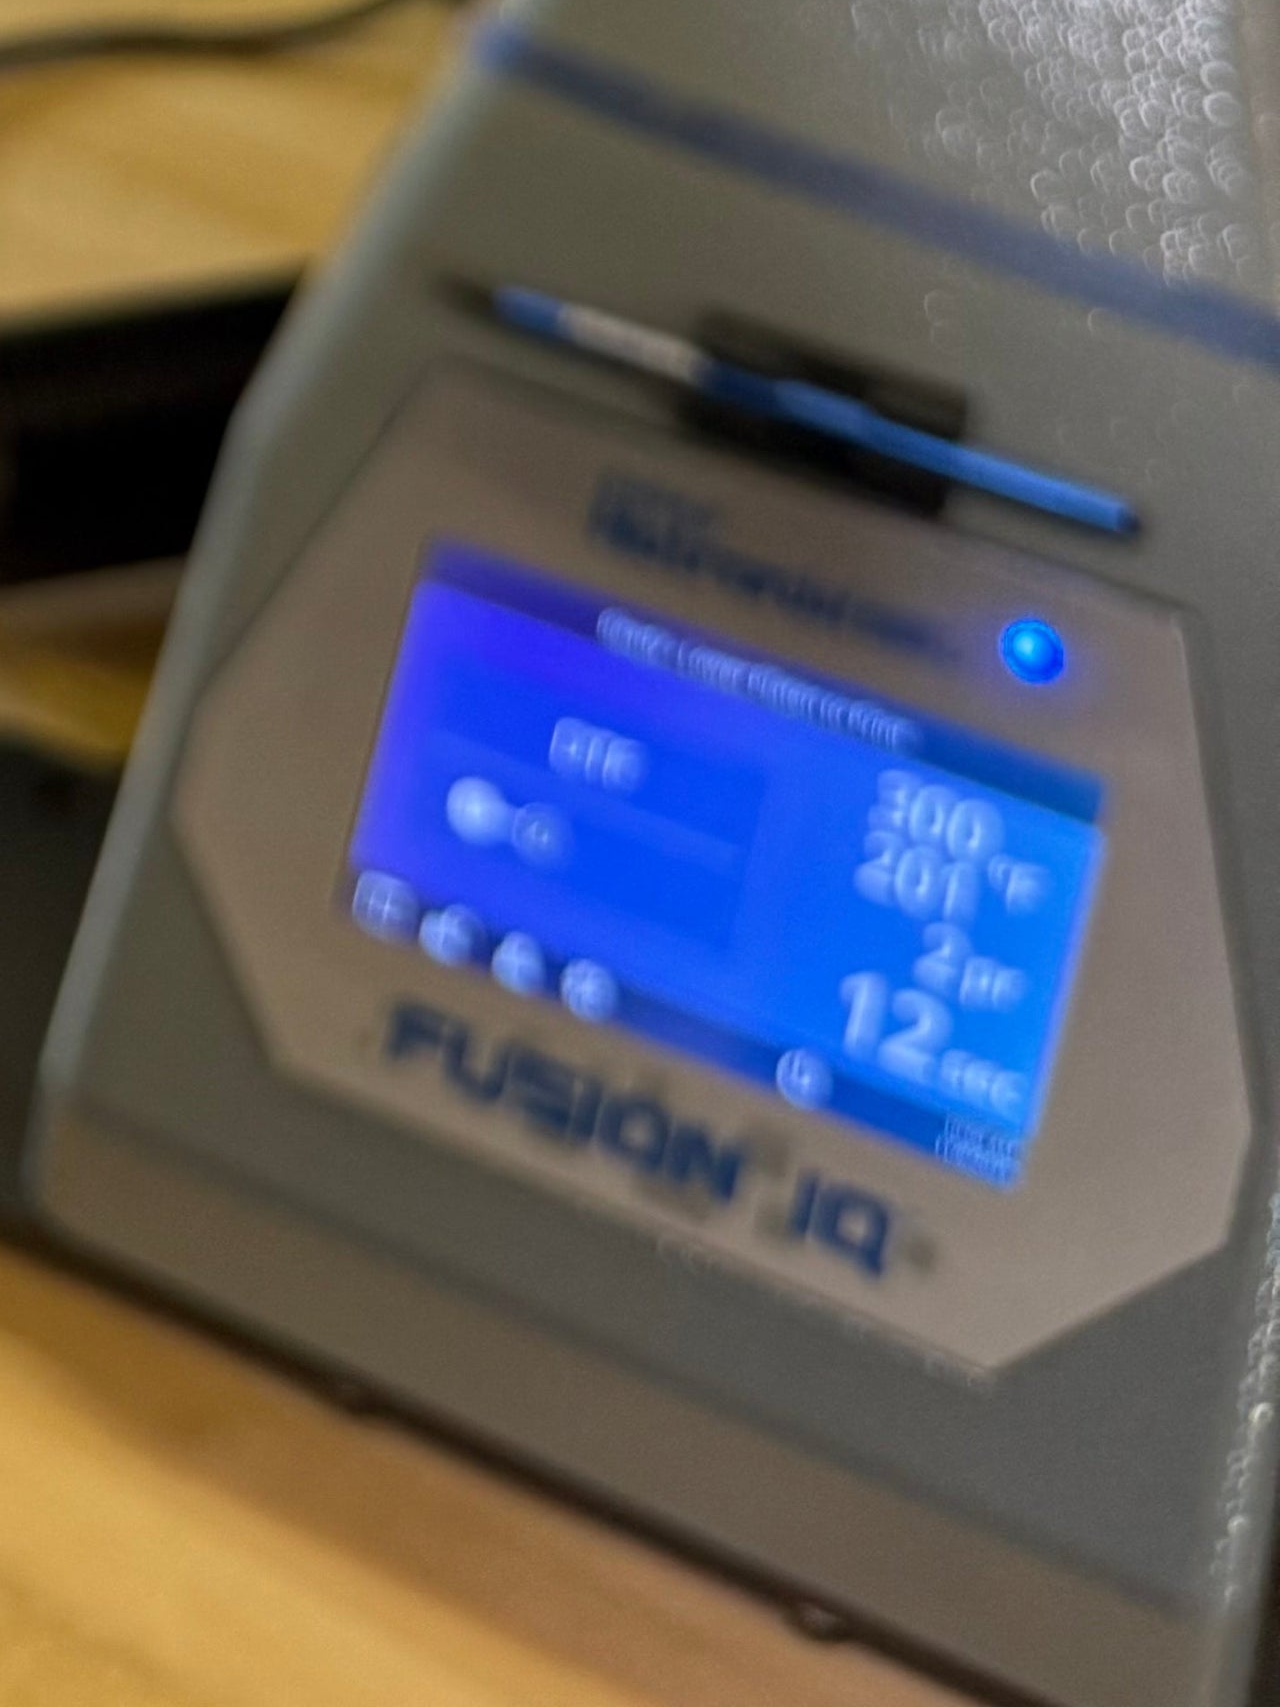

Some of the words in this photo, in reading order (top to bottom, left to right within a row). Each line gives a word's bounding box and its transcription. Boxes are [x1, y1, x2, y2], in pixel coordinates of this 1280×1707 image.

[841, 971, 953, 1083] 12
[385, 1001, 747, 1203] FUSION
[790, 1169, 892, 1277] IQ
